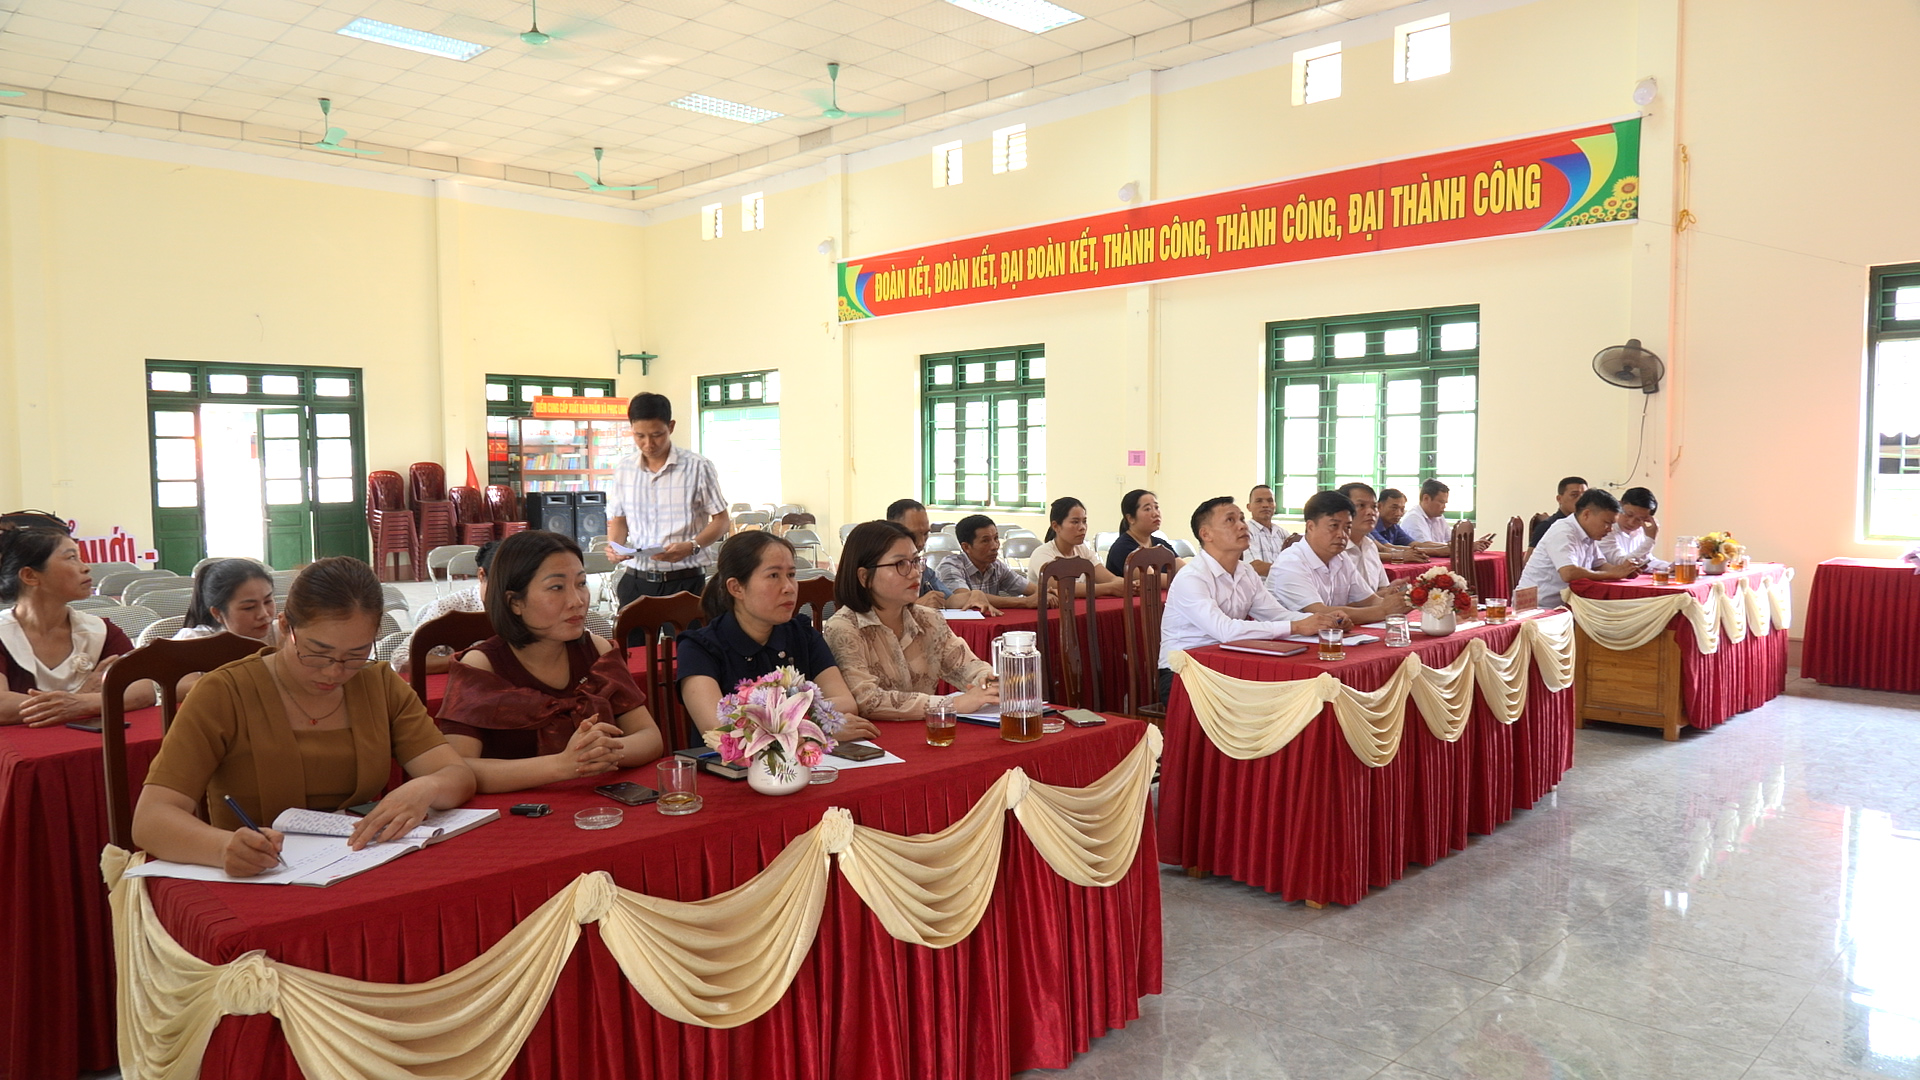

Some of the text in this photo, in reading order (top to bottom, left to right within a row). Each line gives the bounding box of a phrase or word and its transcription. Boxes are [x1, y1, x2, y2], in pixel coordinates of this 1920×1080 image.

[874, 160, 1542, 303] ĐOÀN KẾT, ĐOÀN KẾT, ĐẠI ĐOÀN KẾT, THÀNH CÔNG, THÀNH CÔNG, ĐẠI THÀNH CÔNG
